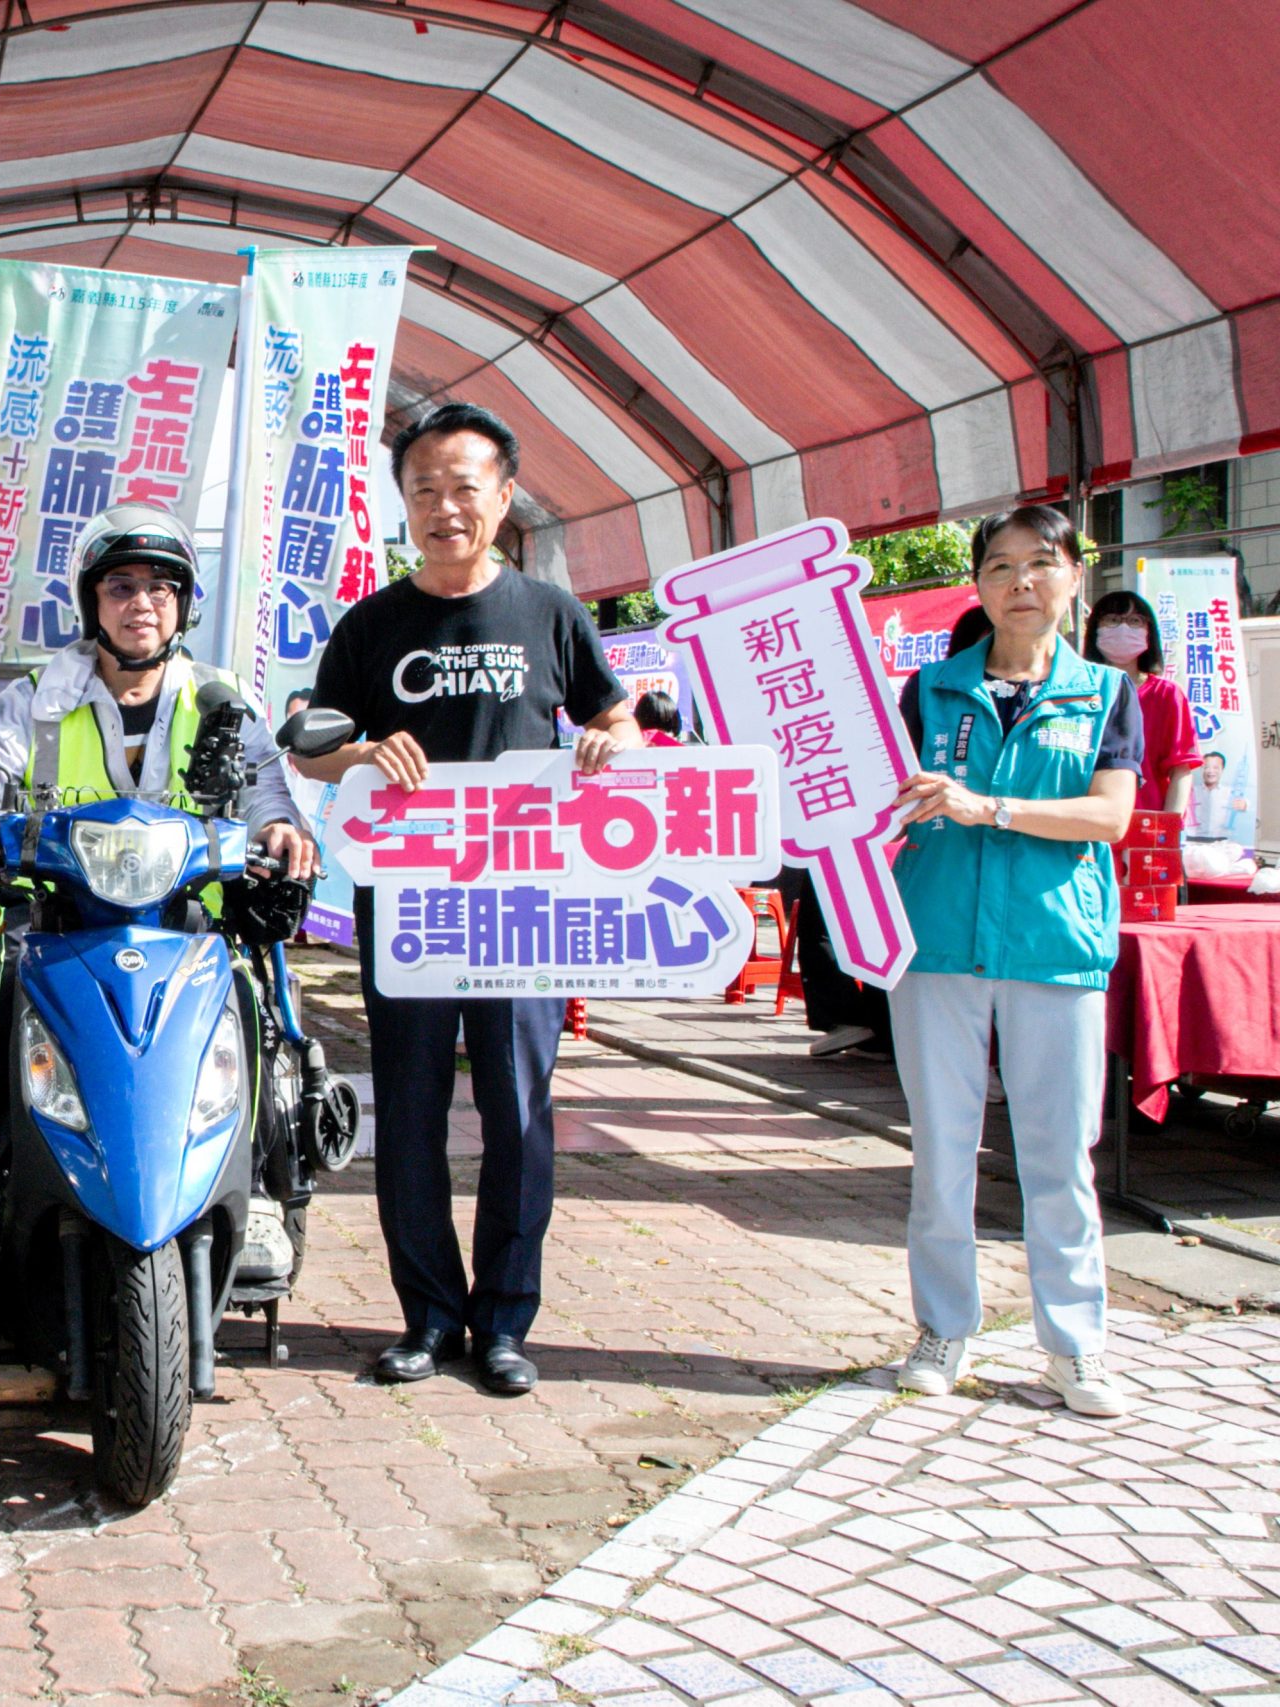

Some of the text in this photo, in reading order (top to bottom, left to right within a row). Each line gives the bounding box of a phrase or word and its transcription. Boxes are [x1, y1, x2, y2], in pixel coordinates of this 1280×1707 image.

[71, 288, 179, 315] 嘉義縣115年度
[273, 372, 345, 660] 護肺顧心
[336, 343, 377, 603] 左流右新
[392, 650, 524, 703] CHIAYI
[440, 643, 524, 655] THE COUNTY OF
[440, 653, 529, 672] THE SUN,
[1186, 612, 1221, 740] 護肺顧心
[1208, 598, 1240, 712] 左流右新
[740, 608, 856, 821] 新冠疫苗
[342, 766, 758, 882] 左流右新
[391, 876, 729, 967] 護肺顧心
[473, 978, 527, 989] 嘉義縣政府
[554, 978, 620, 990] 嘉義縣衛生局
